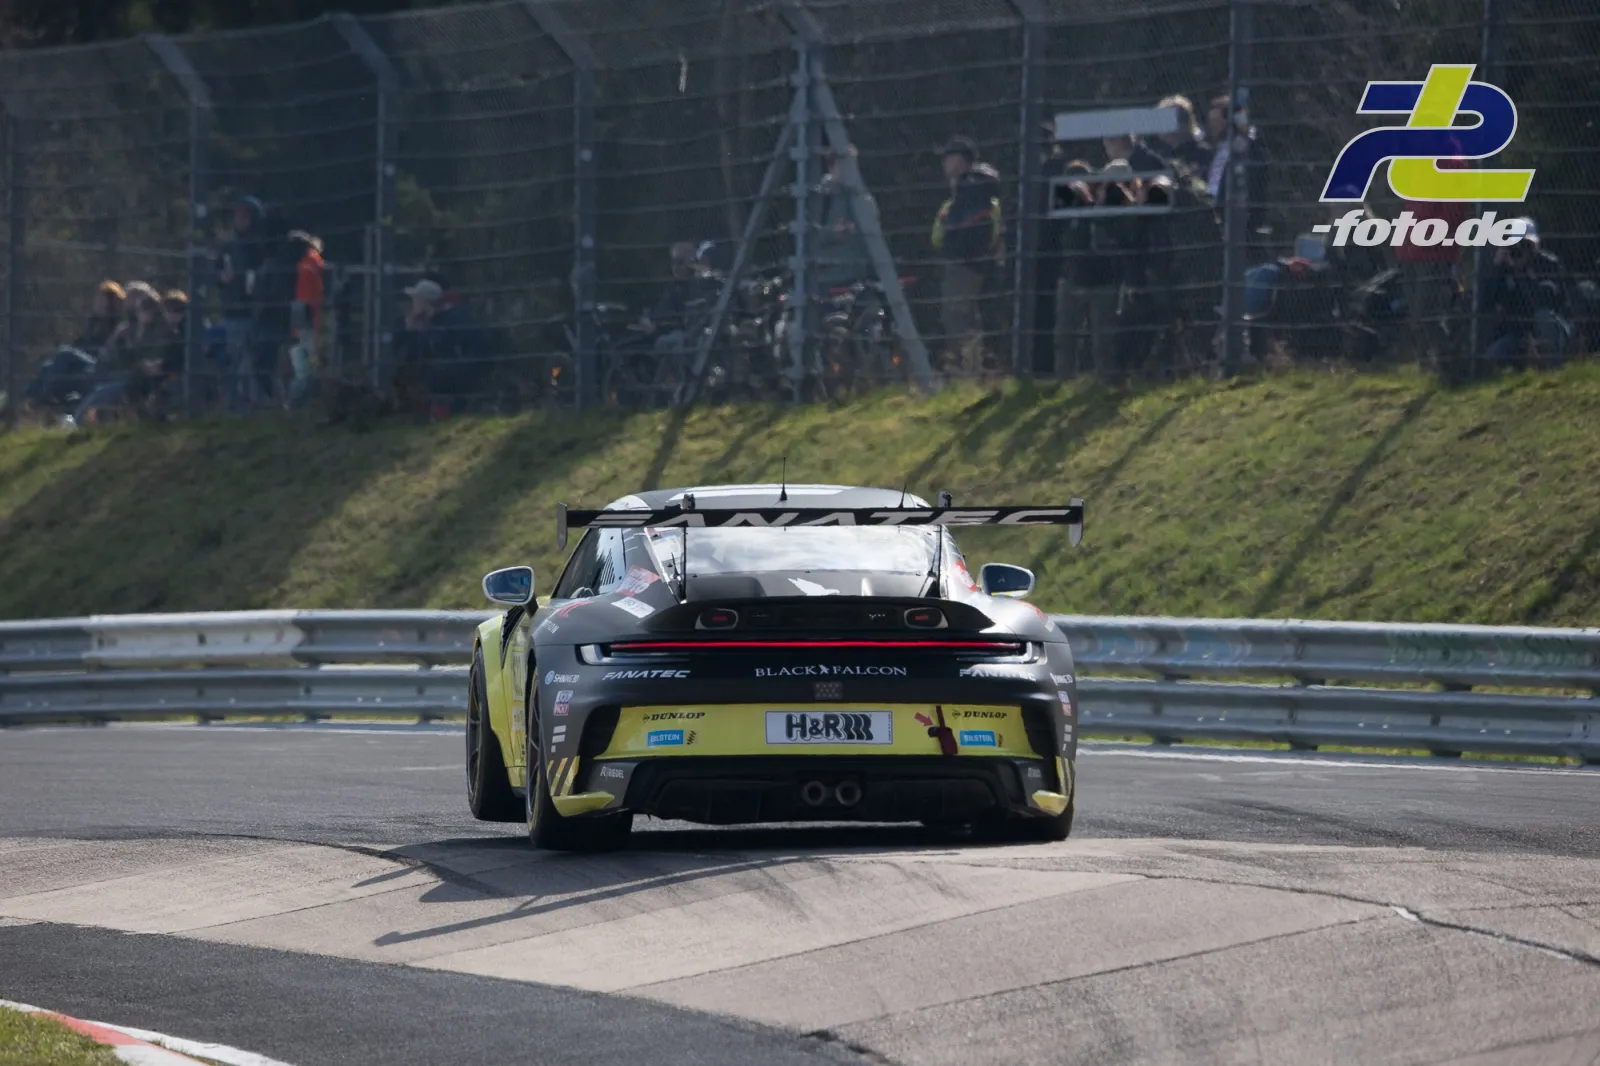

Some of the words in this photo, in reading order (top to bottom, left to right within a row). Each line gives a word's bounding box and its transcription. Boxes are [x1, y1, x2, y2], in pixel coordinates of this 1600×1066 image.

[582, 509, 1071, 528] FANATEC
[602, 669, 691, 681] FANATEC
[755, 666, 816, 677] BLACK
[832, 665, 907, 676] FALCON
[651, 711, 706, 721] DUNLOP
[963, 710, 1007, 720] DUNLOP
